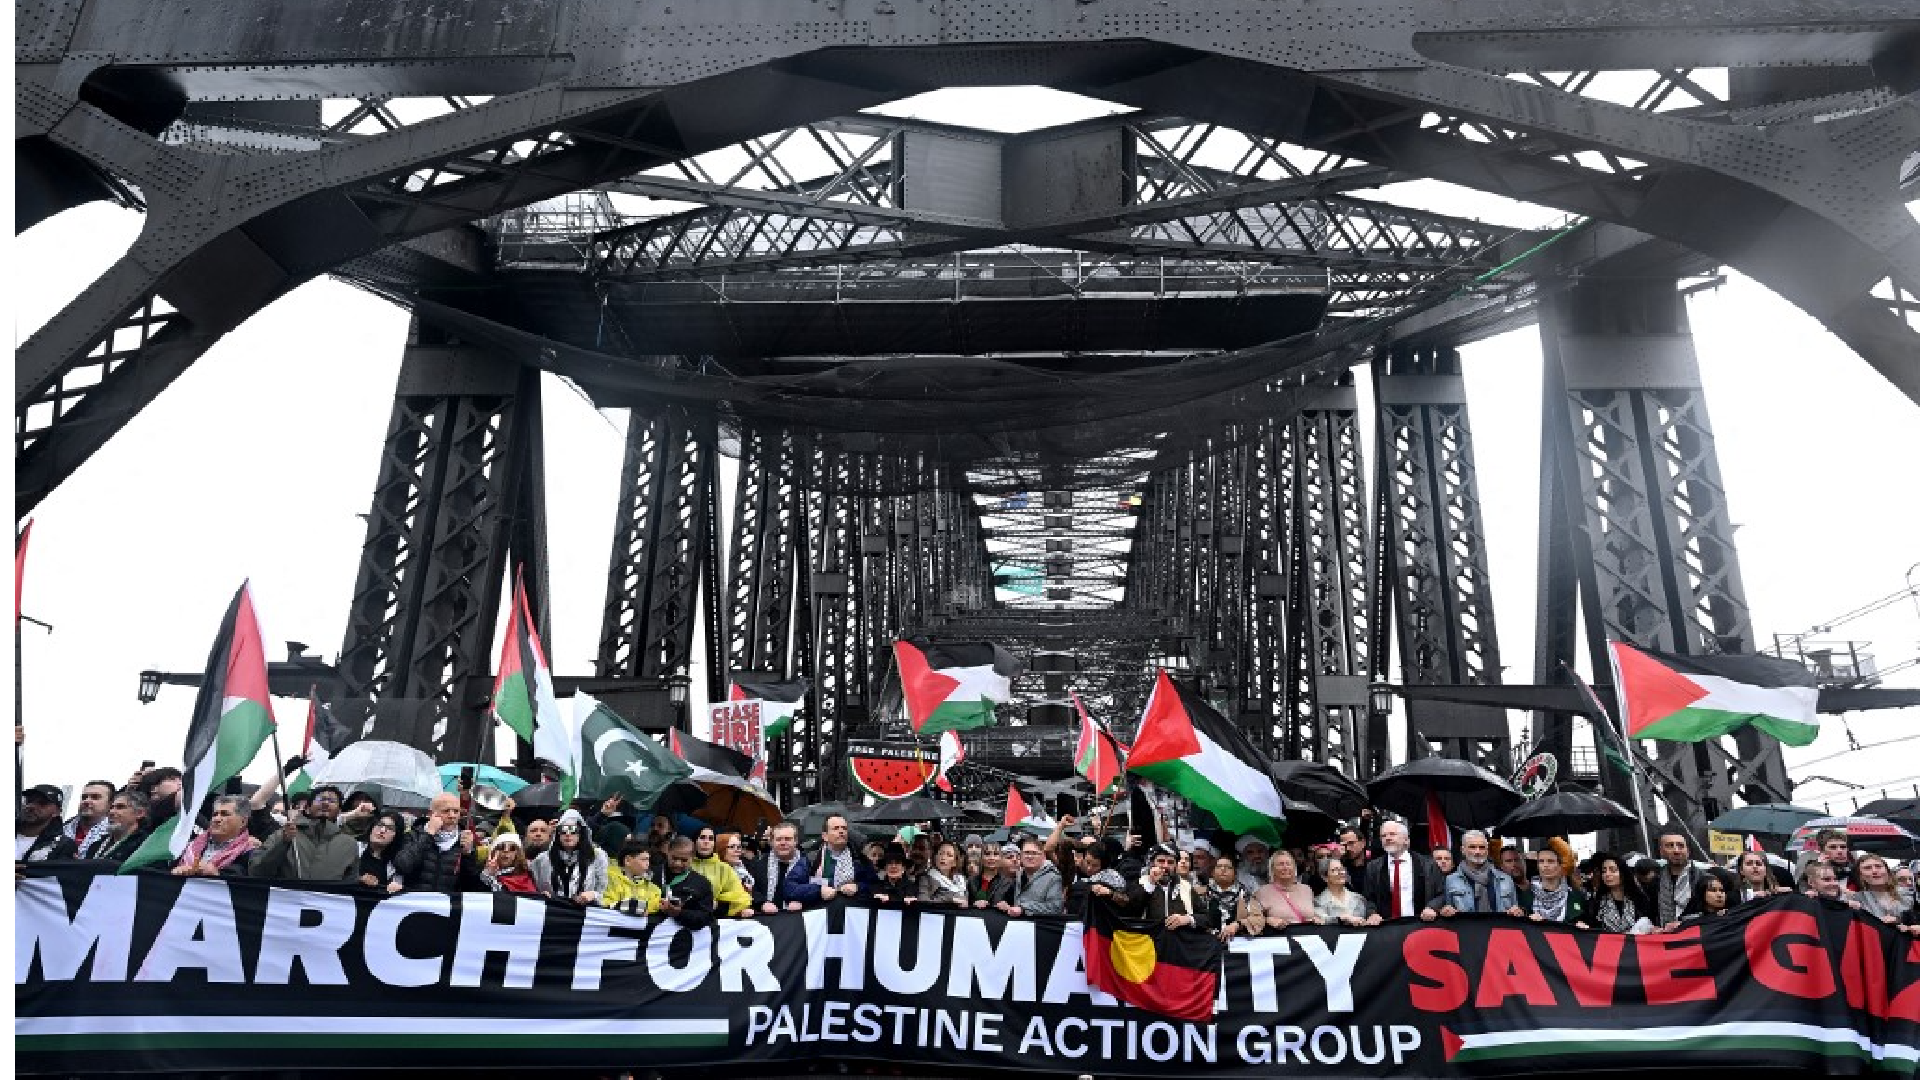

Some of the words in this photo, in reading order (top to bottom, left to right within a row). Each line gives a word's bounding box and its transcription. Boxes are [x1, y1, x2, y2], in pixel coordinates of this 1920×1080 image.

[712, 703, 760, 722] CEASE
[712, 721, 760, 744] FIRE
[847, 745, 875, 754] FREE
[881, 747, 939, 760] PALESTINE
[15, 875, 546, 987] MARCH
[571, 908, 781, 992] FOR
[805, 909, 1367, 1013] HUMATY
[1403, 926, 1716, 1012] SAVE
[746, 1002, 1005, 1052] PALESTINE
[1019, 1015, 1218, 1063] ACTION
[1236, 1025, 1421, 1065] GROUP
